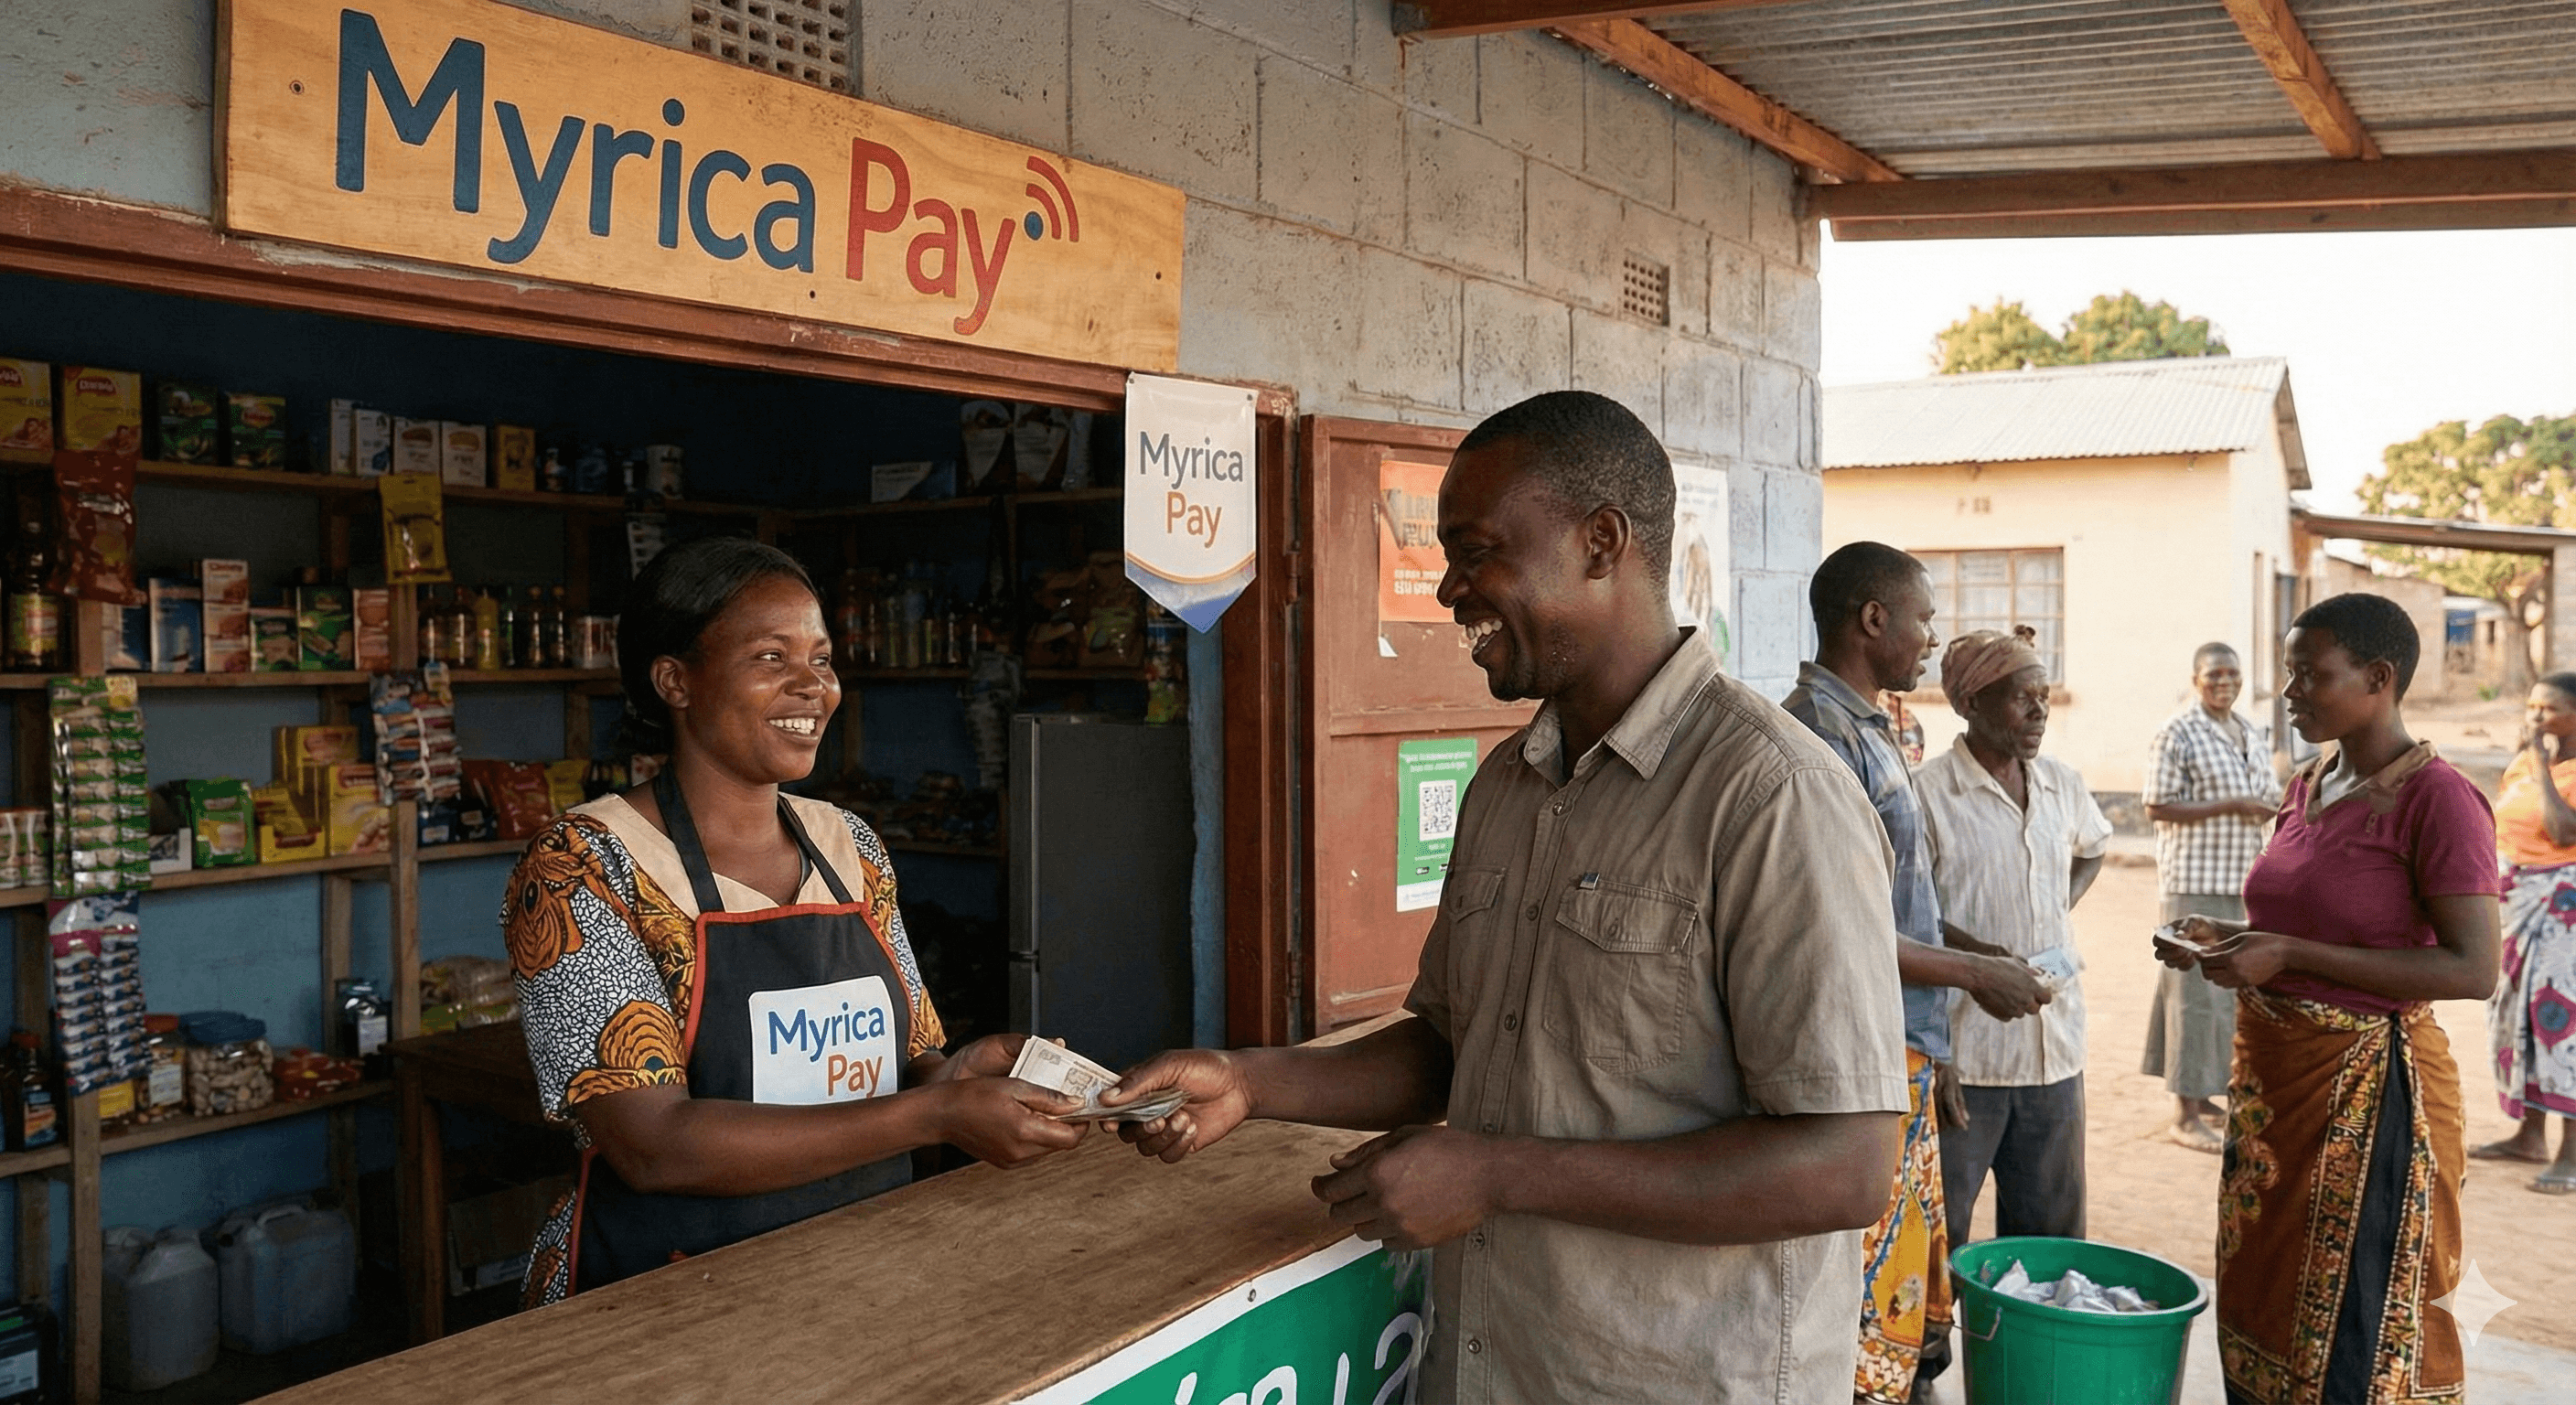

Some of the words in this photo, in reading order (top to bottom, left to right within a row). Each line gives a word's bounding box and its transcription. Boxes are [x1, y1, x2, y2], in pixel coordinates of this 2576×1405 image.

[336, 8, 817, 273] Myrica
[846, 136, 1017, 336] Pay
[1140, 431, 1243, 489] Myrica
[1166, 490, 1222, 549] Pay
[768, 1002, 886, 1063] Myrica
[828, 1054, 883, 1099] Pay
